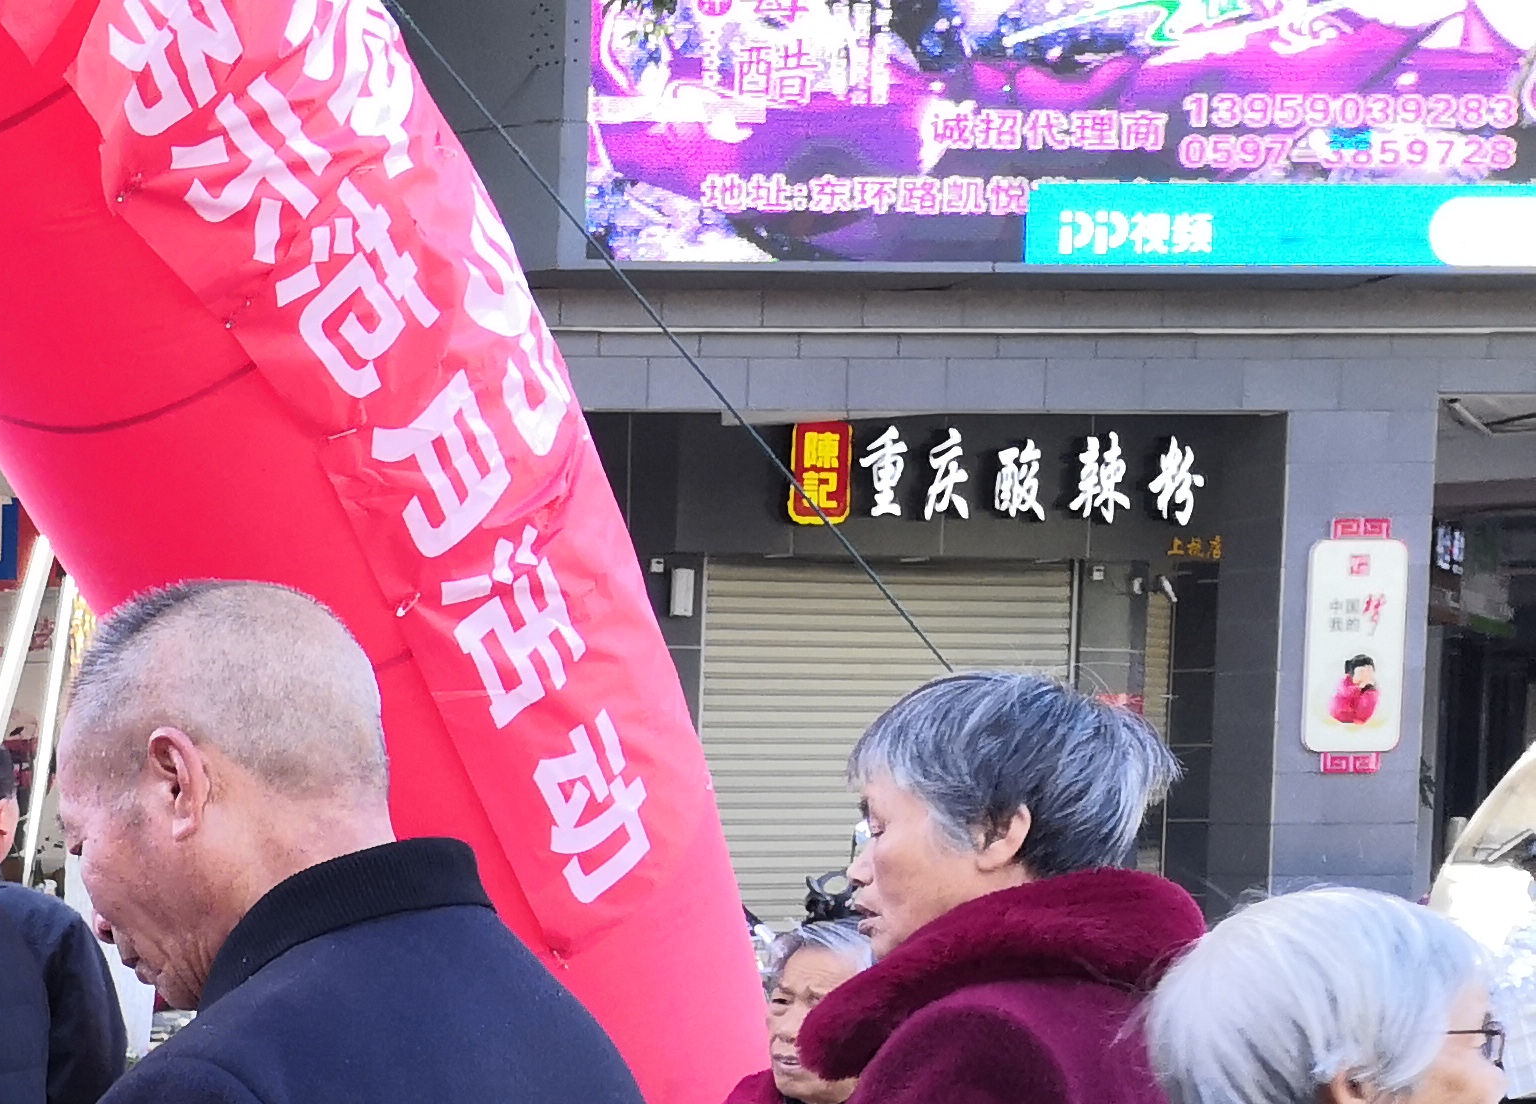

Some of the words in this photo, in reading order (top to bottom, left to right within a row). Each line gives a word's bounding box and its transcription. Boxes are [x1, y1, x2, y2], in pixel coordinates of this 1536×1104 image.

[930, 109, 1169, 150] 诚招代理商
[1182, 93, 1518, 128] 13959039283
[859, 425, 1205, 526] 重庆酸辣粉
